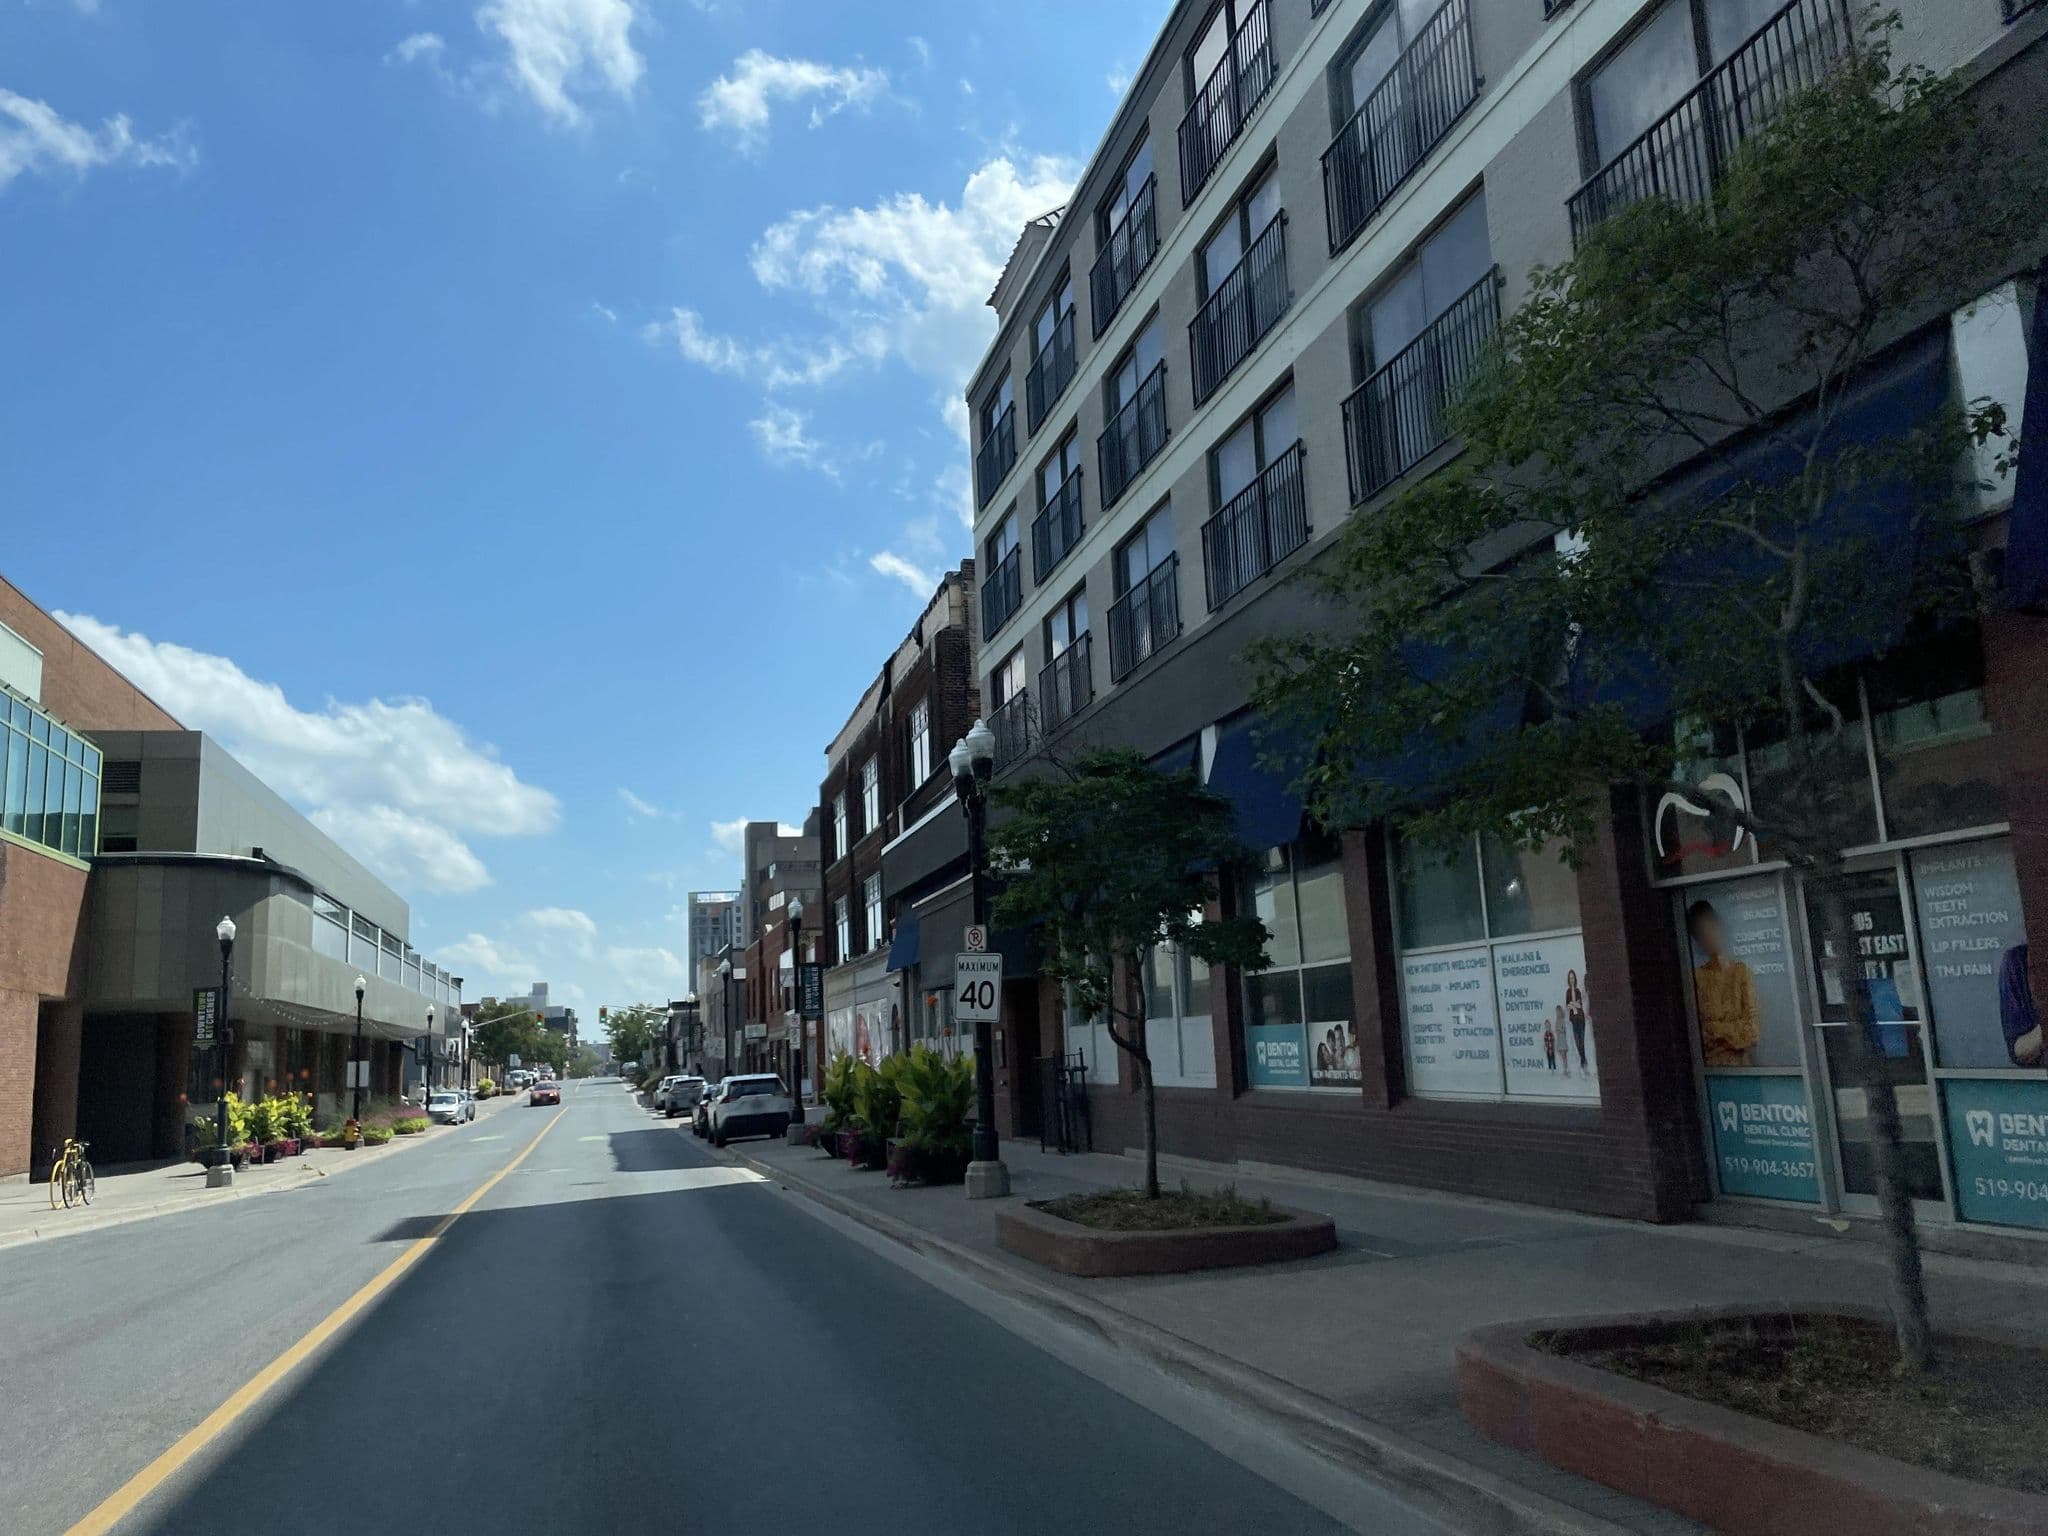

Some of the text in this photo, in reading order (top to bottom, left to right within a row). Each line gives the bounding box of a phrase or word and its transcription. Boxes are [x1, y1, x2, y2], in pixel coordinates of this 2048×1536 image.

[1924, 881, 1974, 898] WISDOM
[1927, 899, 1968, 913] TEETH
[1928, 910, 2009, 930] EXTRACTION
[1858, 935, 1873, 955] ST
[1874, 933, 1905, 955] EAST
[1931, 937, 2001, 953] LIP FILLERS
[958, 961, 999, 973] MAXIMUM
[1935, 962, 1993, 977] TMJ PAIN
[959, 980, 995, 1010] 40
[1504, 987, 1529, 998] FAMILY
[1505, 1000, 1544, 1012] DENTISTRY
[196, 991, 206, 1039] DOWNTOWN
[205, 991, 215, 1039] KITCHENER
[1452, 1015, 1473, 1025] TETH
[1507, 1023, 1542, 1033] SAME DAY
[1267, 1041, 1299, 1057] BENTON
[1509, 1036, 1534, 1047] EXAMS
[1741, 1103, 1809, 1124] BENTON
[1743, 1124, 1811, 1138] DENTAL CLINIC
